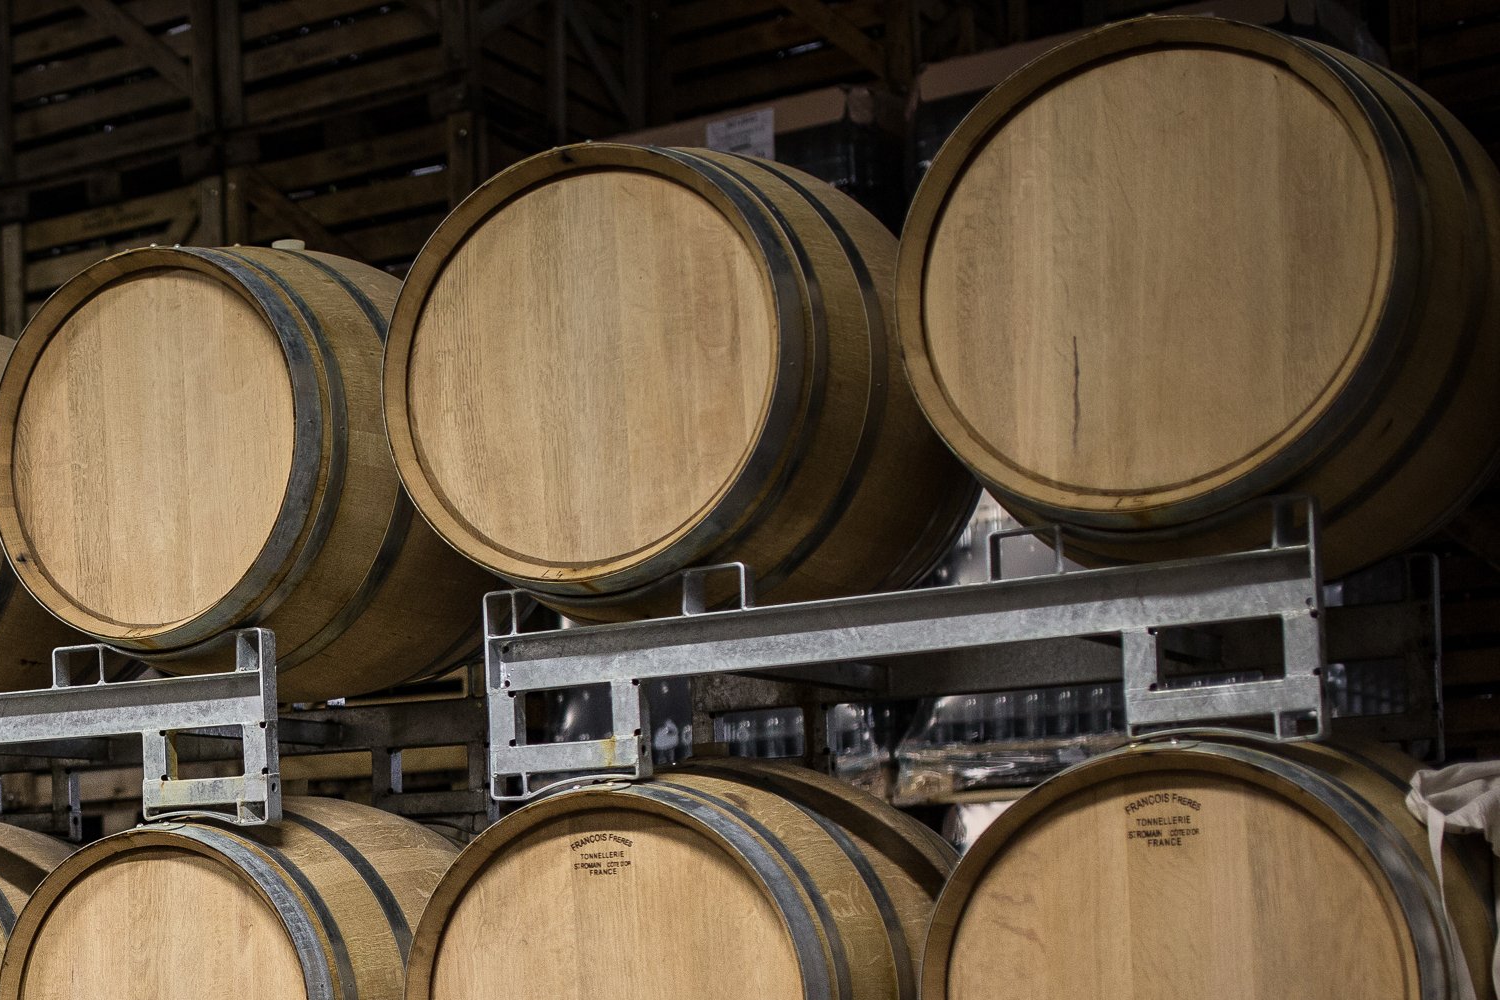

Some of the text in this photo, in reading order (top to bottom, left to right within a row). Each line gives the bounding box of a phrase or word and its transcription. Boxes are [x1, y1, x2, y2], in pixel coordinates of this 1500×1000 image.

[1136, 815, 1191, 827] TONNELLERIE
[1147, 837, 1182, 847] FRANCE
[580, 850, 625, 860] TONNELLERIE
[589, 867, 618, 876] FRANCE
